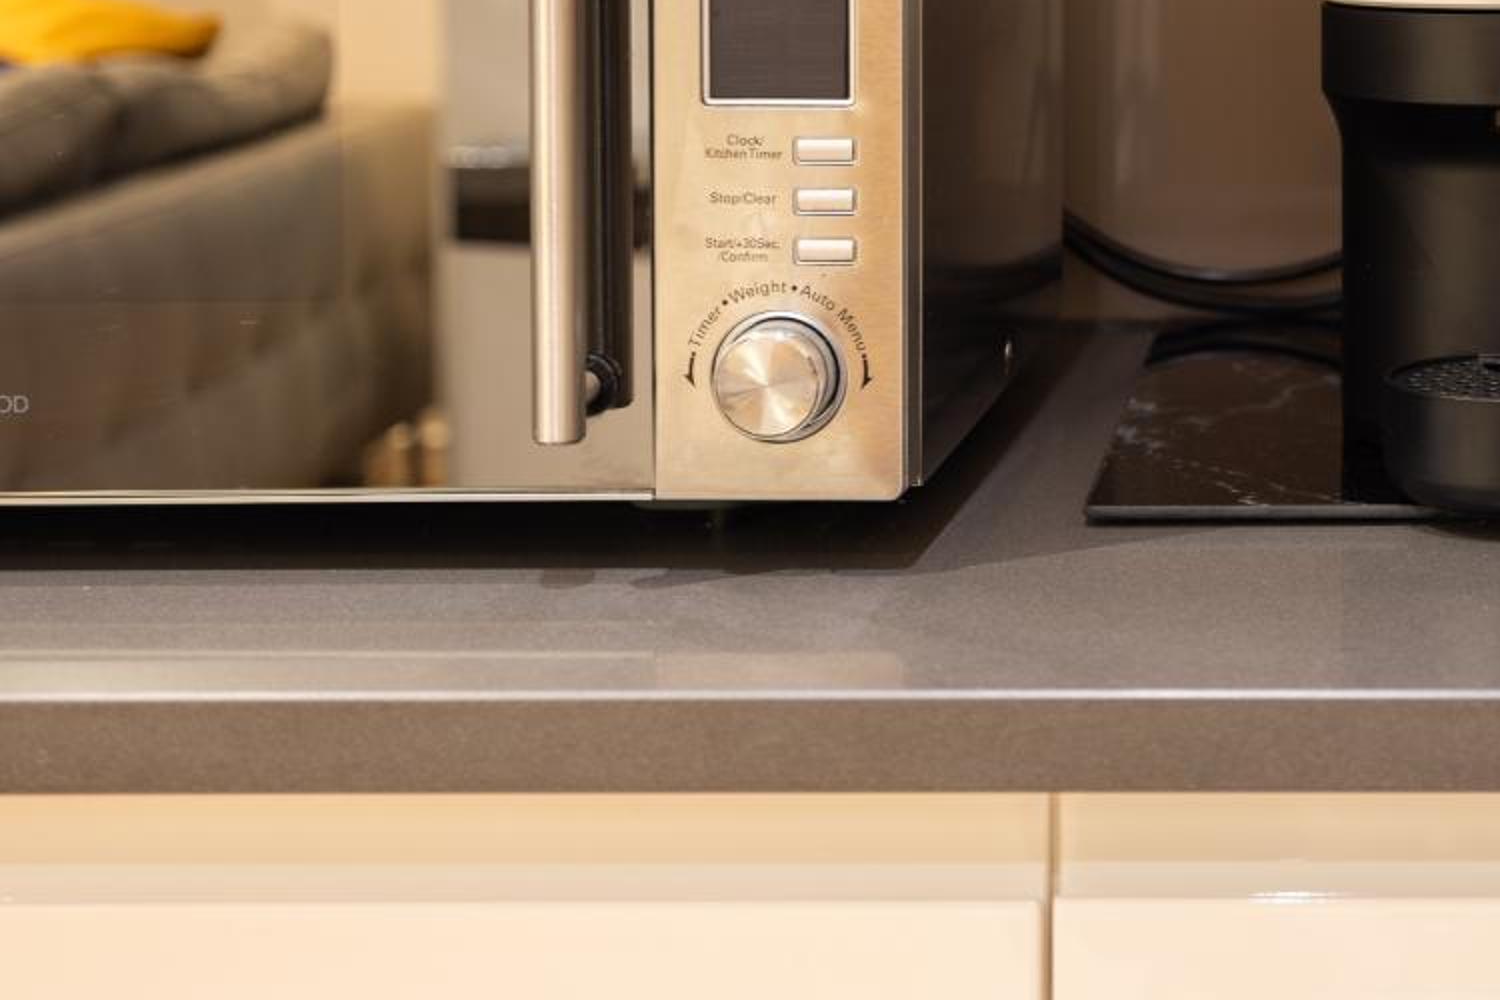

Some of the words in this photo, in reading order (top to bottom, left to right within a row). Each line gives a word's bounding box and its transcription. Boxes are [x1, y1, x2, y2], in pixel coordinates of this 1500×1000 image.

[748, 147, 783, 160] Timer
[688, 305, 722, 347] Timer
[728, 281, 788, 304] Weight
[800, 285, 836, 311] Auto
[838, 307, 866, 351] Menu
